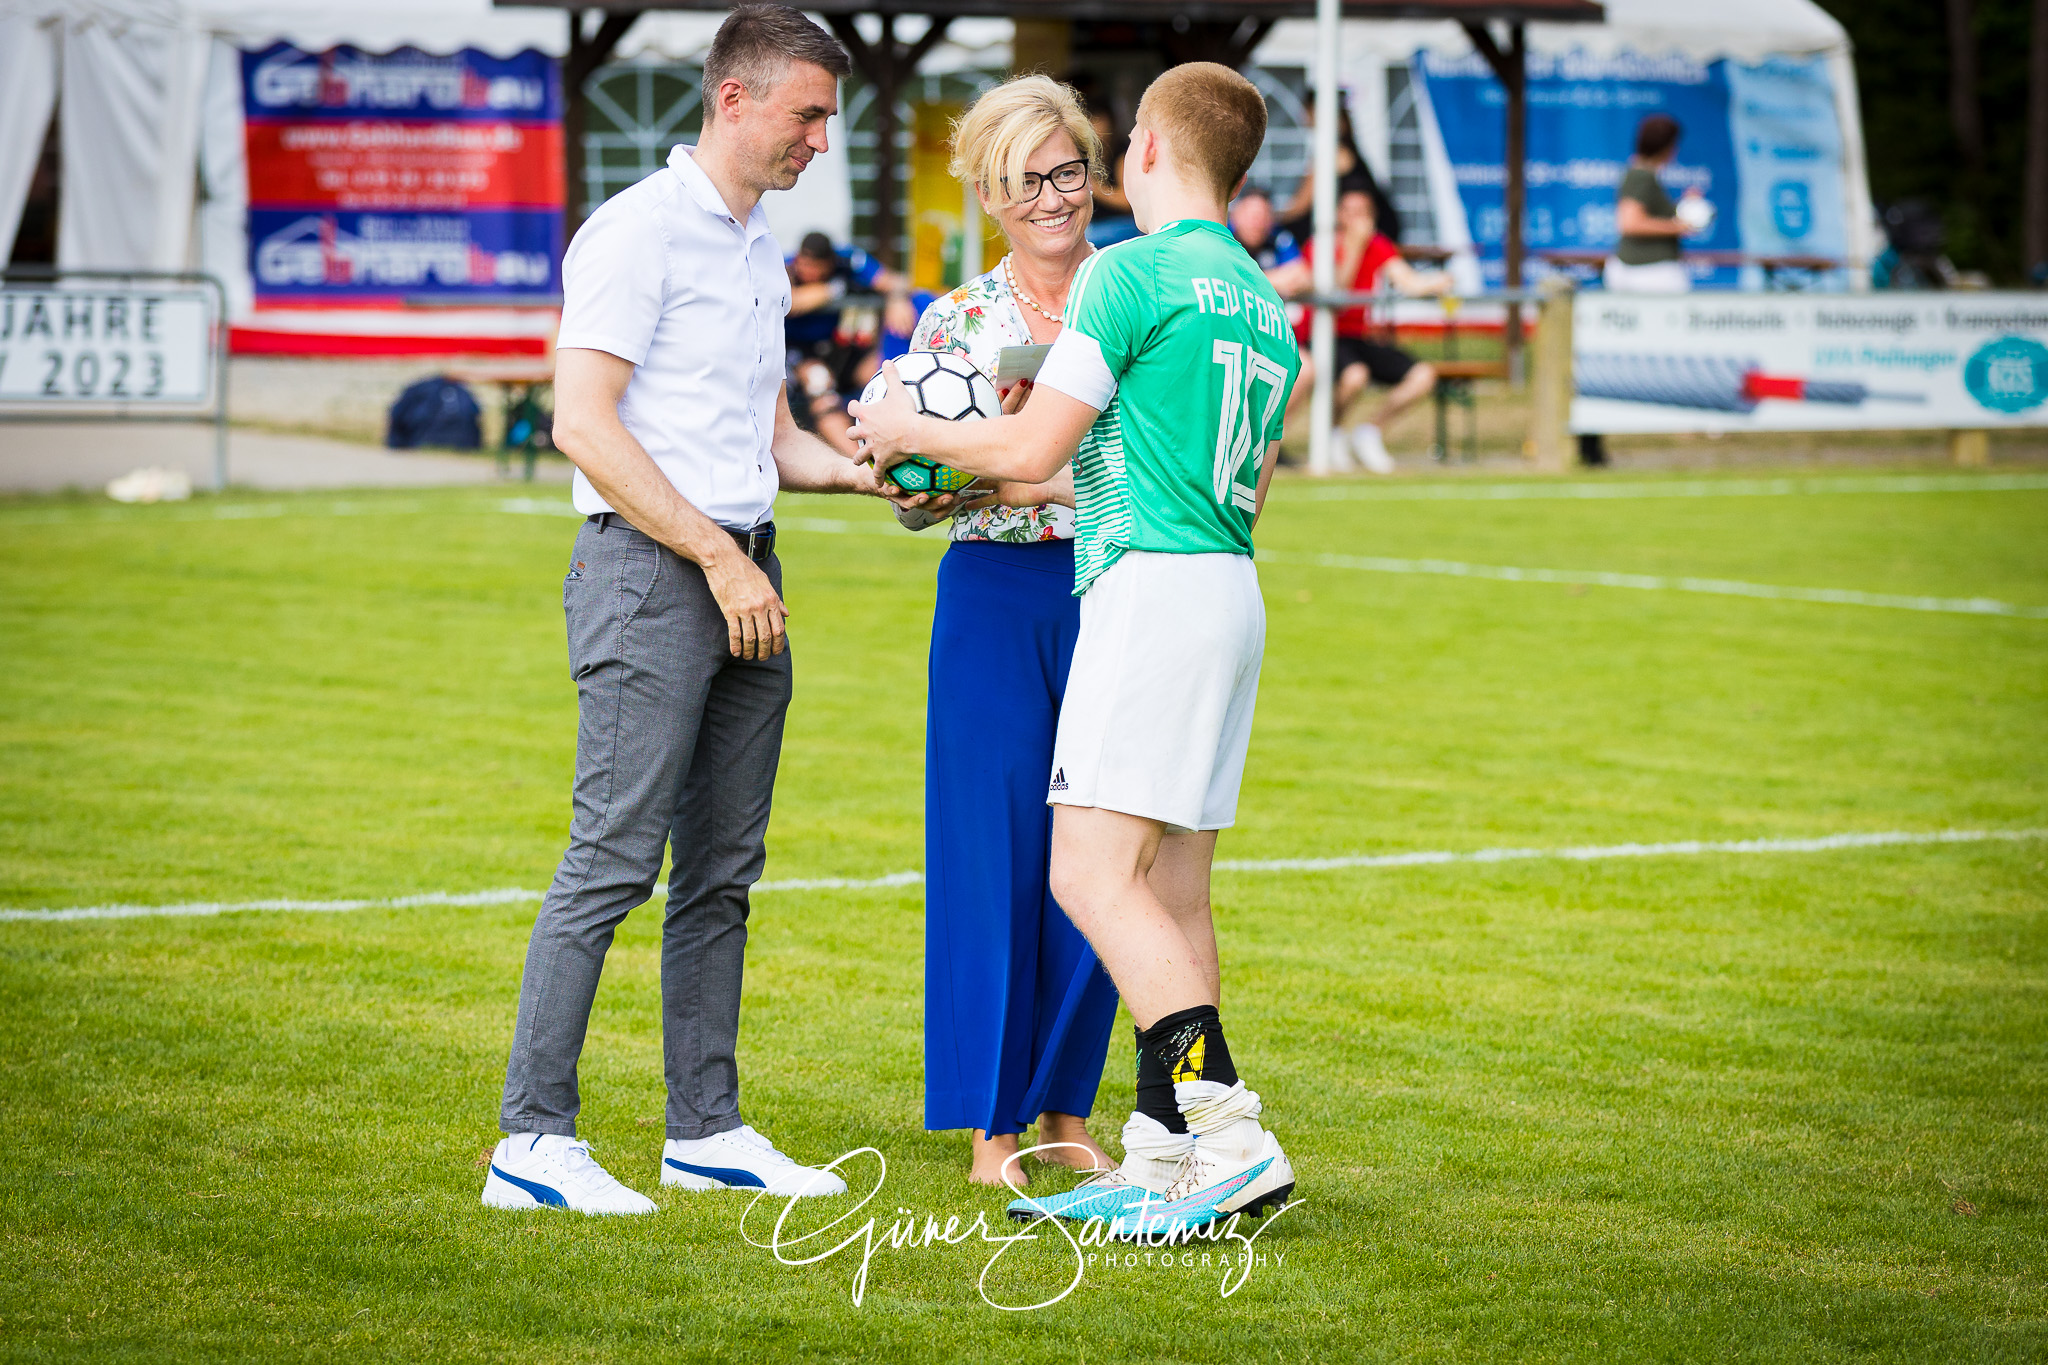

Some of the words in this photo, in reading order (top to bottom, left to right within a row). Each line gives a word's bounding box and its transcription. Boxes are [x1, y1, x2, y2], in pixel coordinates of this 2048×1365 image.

[1, 296, 162, 340] JAHRE
[1191, 277, 1241, 317] ASV
[41, 350, 165, 396] 2023
